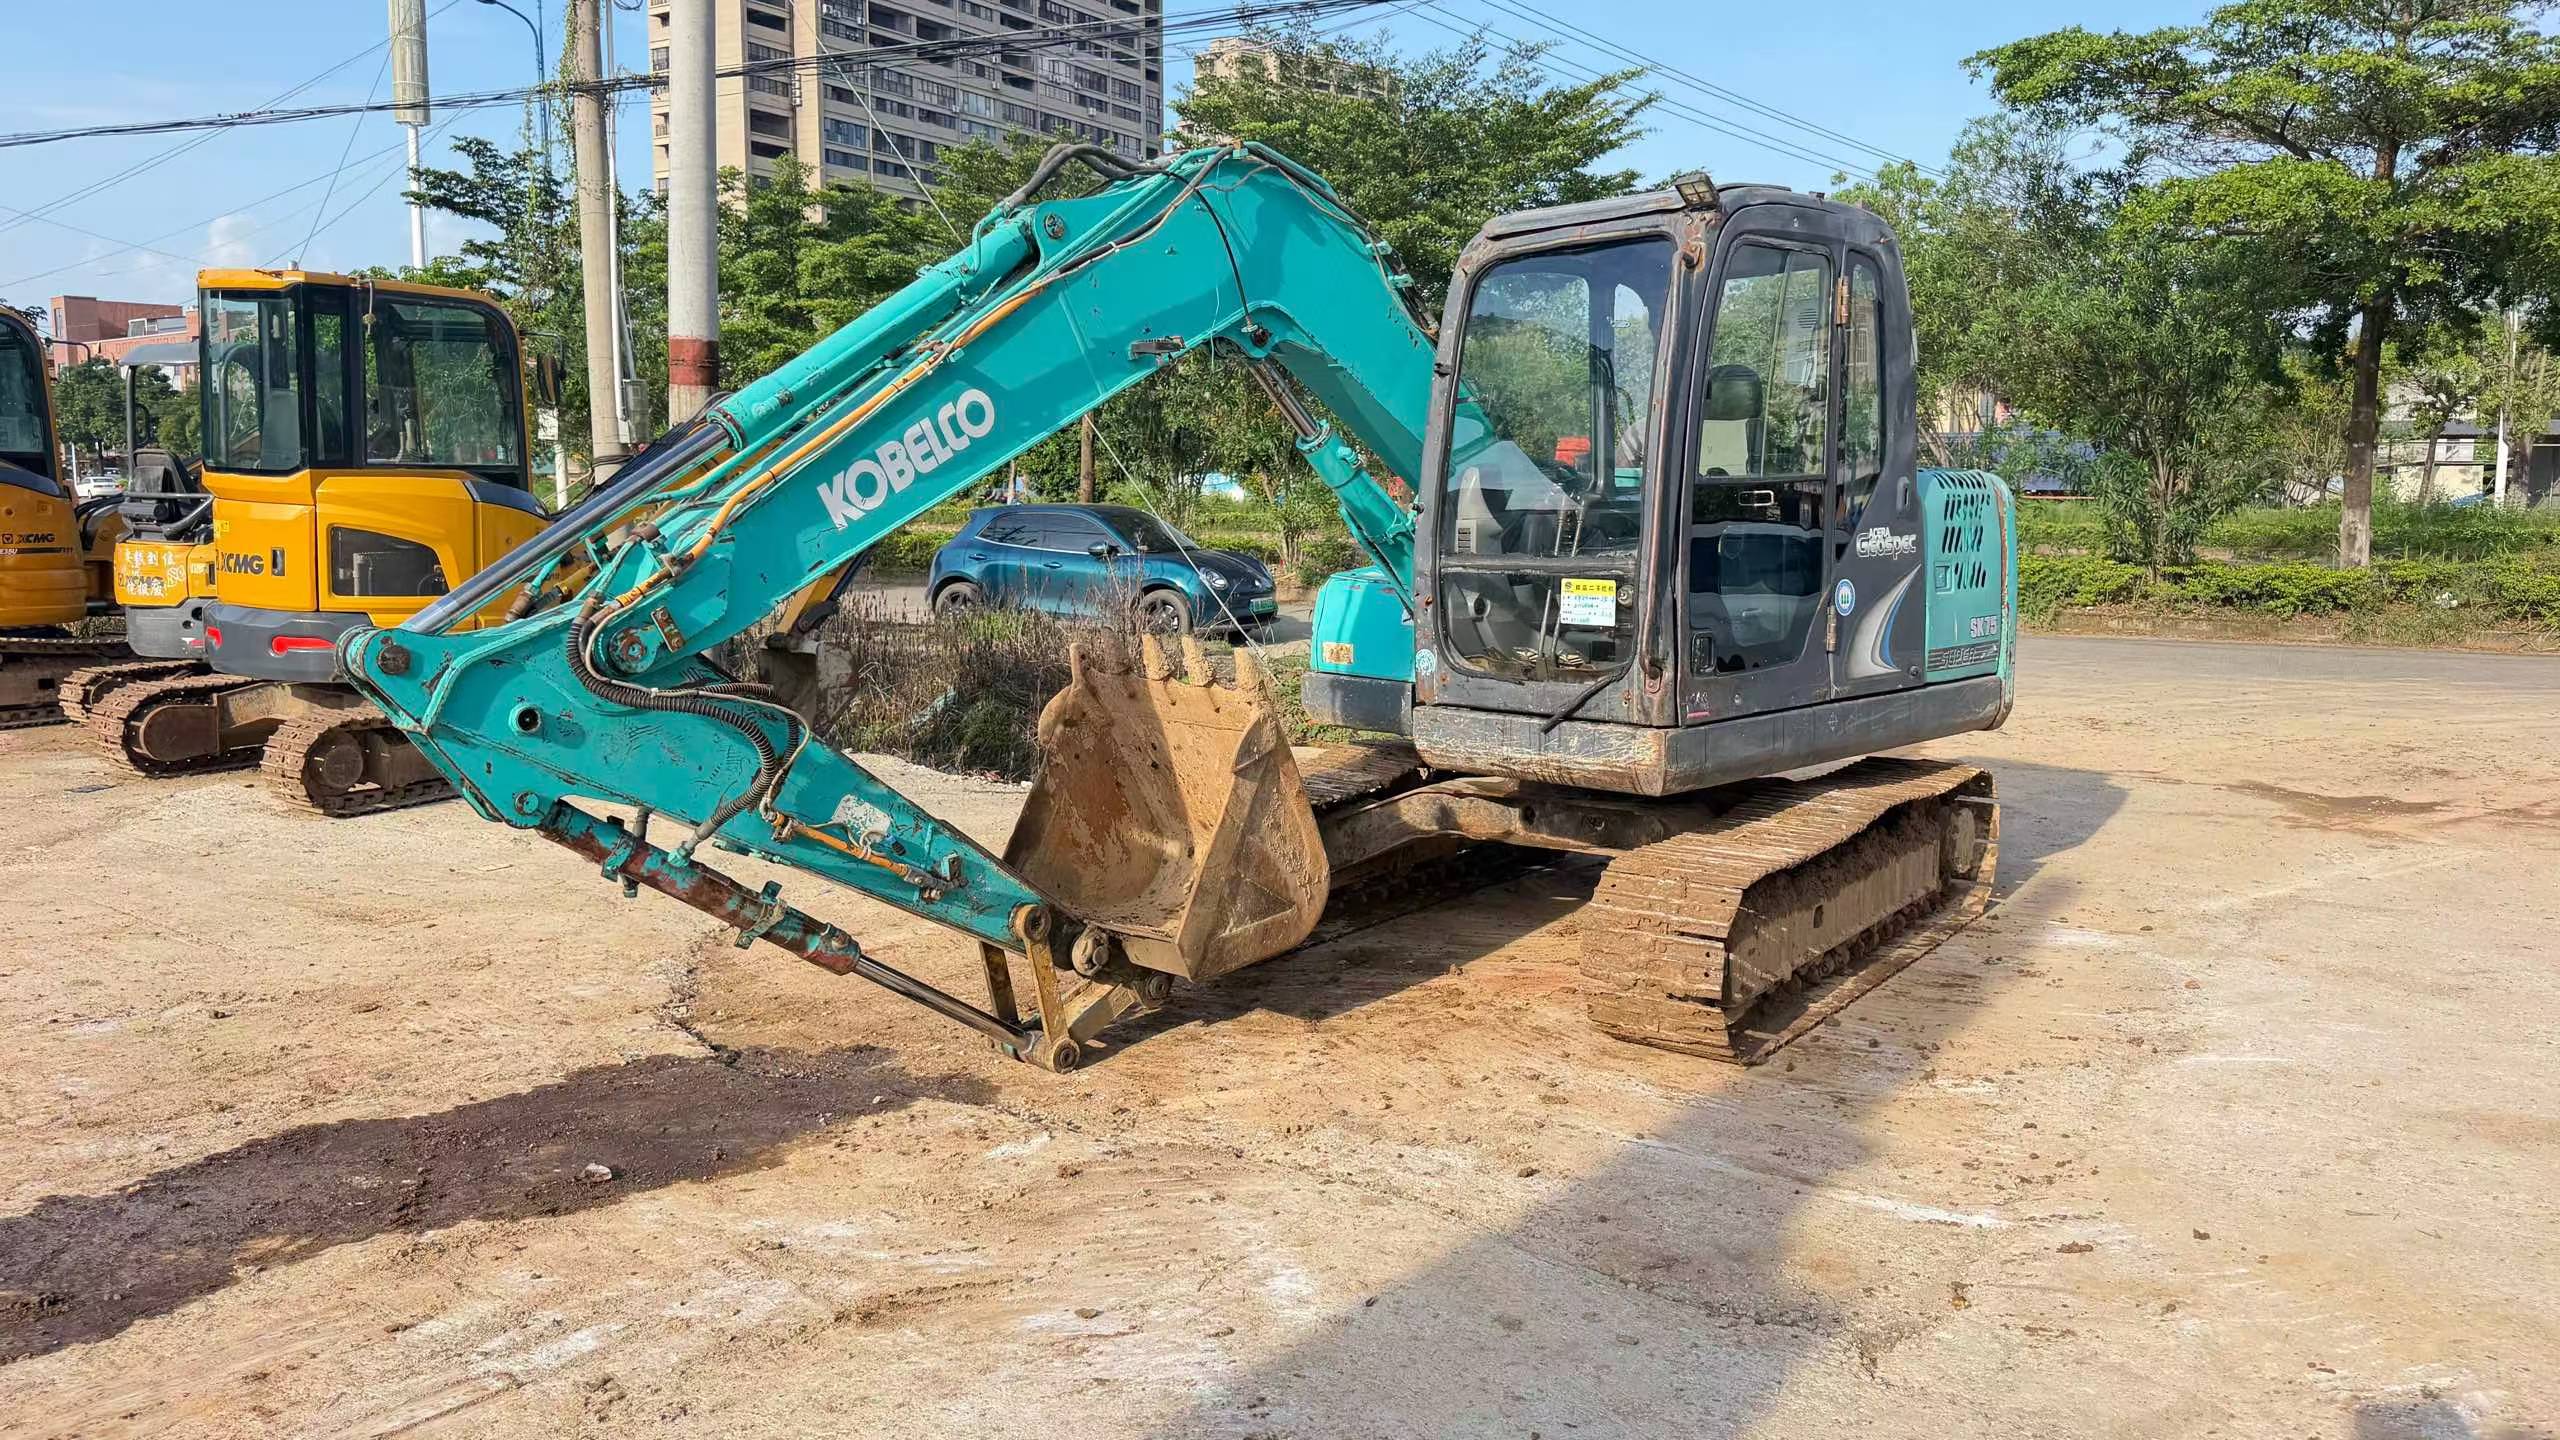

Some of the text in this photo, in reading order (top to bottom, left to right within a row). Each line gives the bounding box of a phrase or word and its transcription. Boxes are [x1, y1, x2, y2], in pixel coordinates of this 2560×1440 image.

[816, 388, 995, 531] KOBELCO
[15, 533, 55, 543] XCMG
[1868, 527, 1891, 538] ACERA
[220, 551, 265, 575] XCMG
[1970, 615, 1997, 638] SK75
